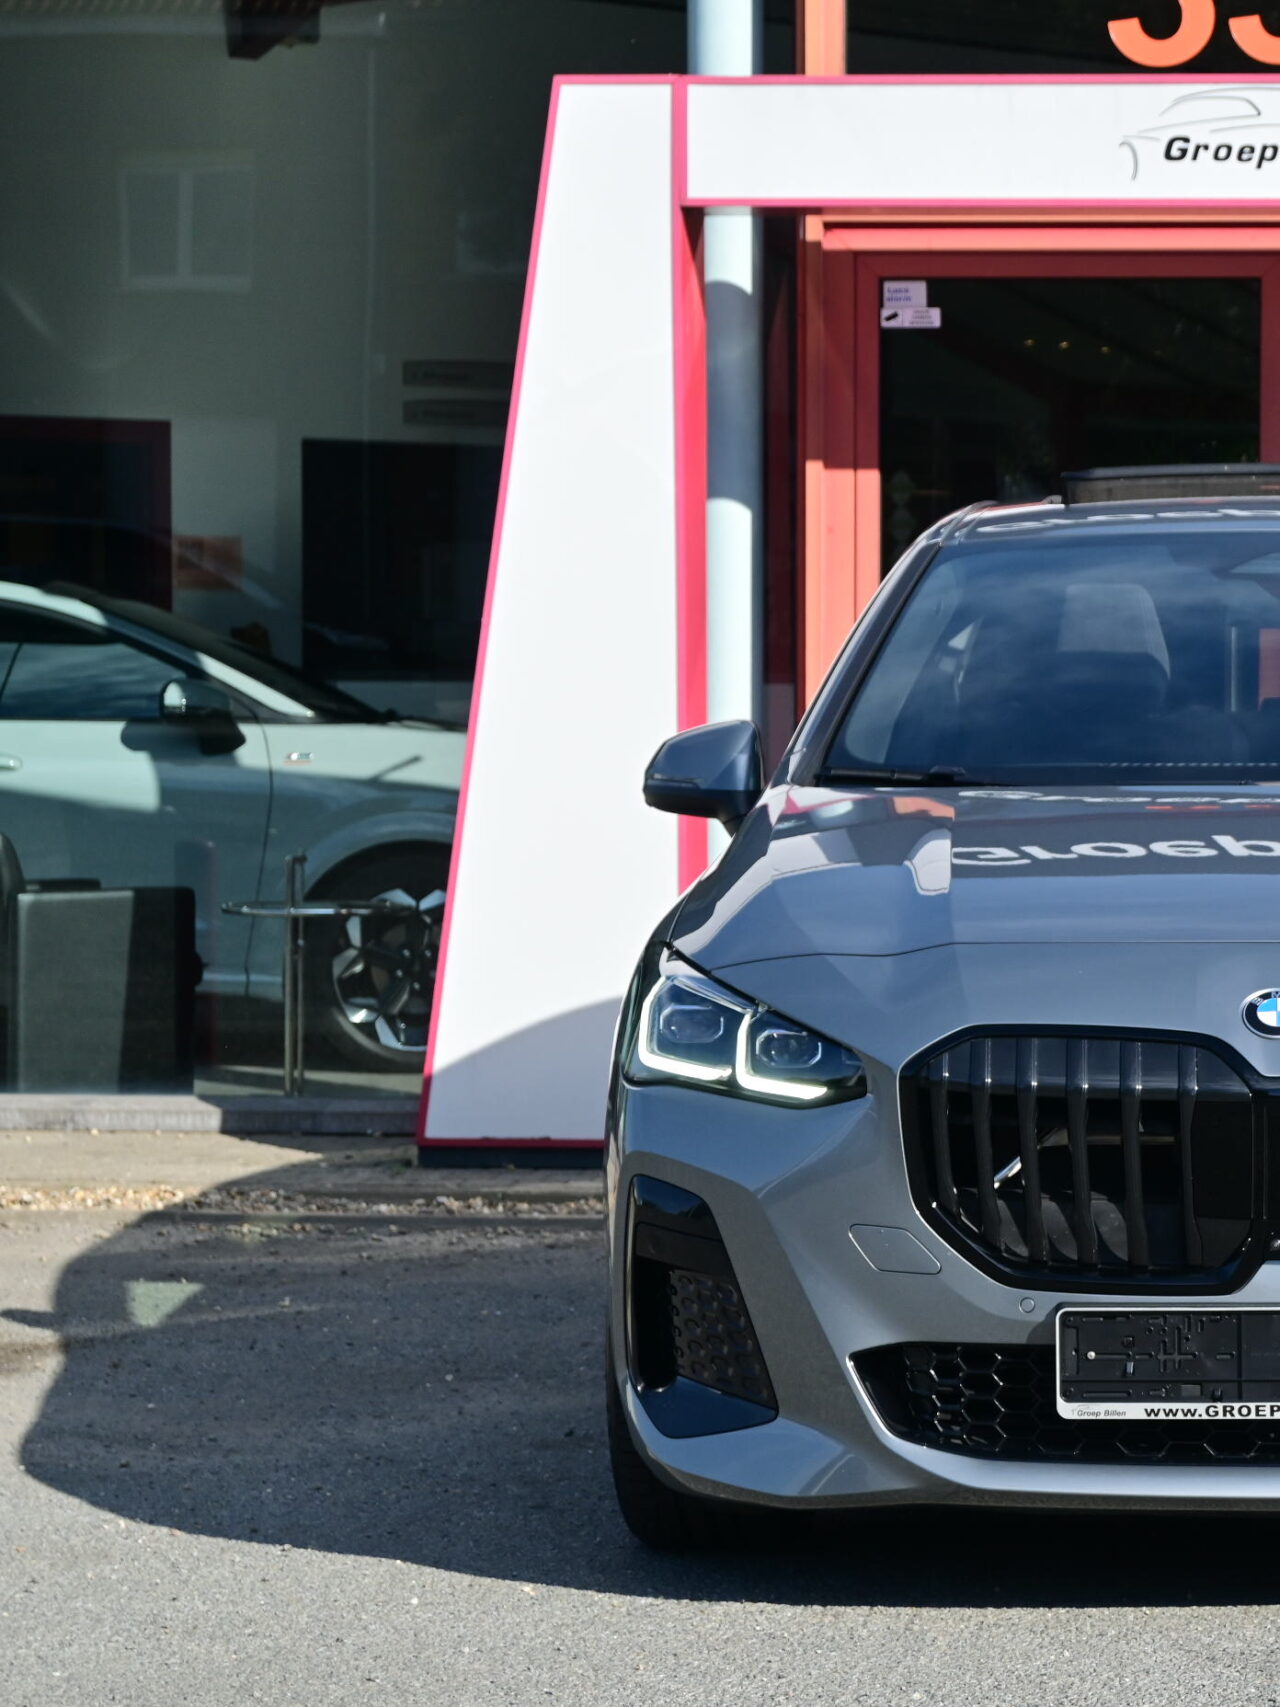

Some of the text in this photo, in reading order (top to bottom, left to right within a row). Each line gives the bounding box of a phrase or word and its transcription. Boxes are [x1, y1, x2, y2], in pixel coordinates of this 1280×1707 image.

[1164, 136, 1279, 169] Groep
[1077, 1408, 1127, 1418] Groep Billen
